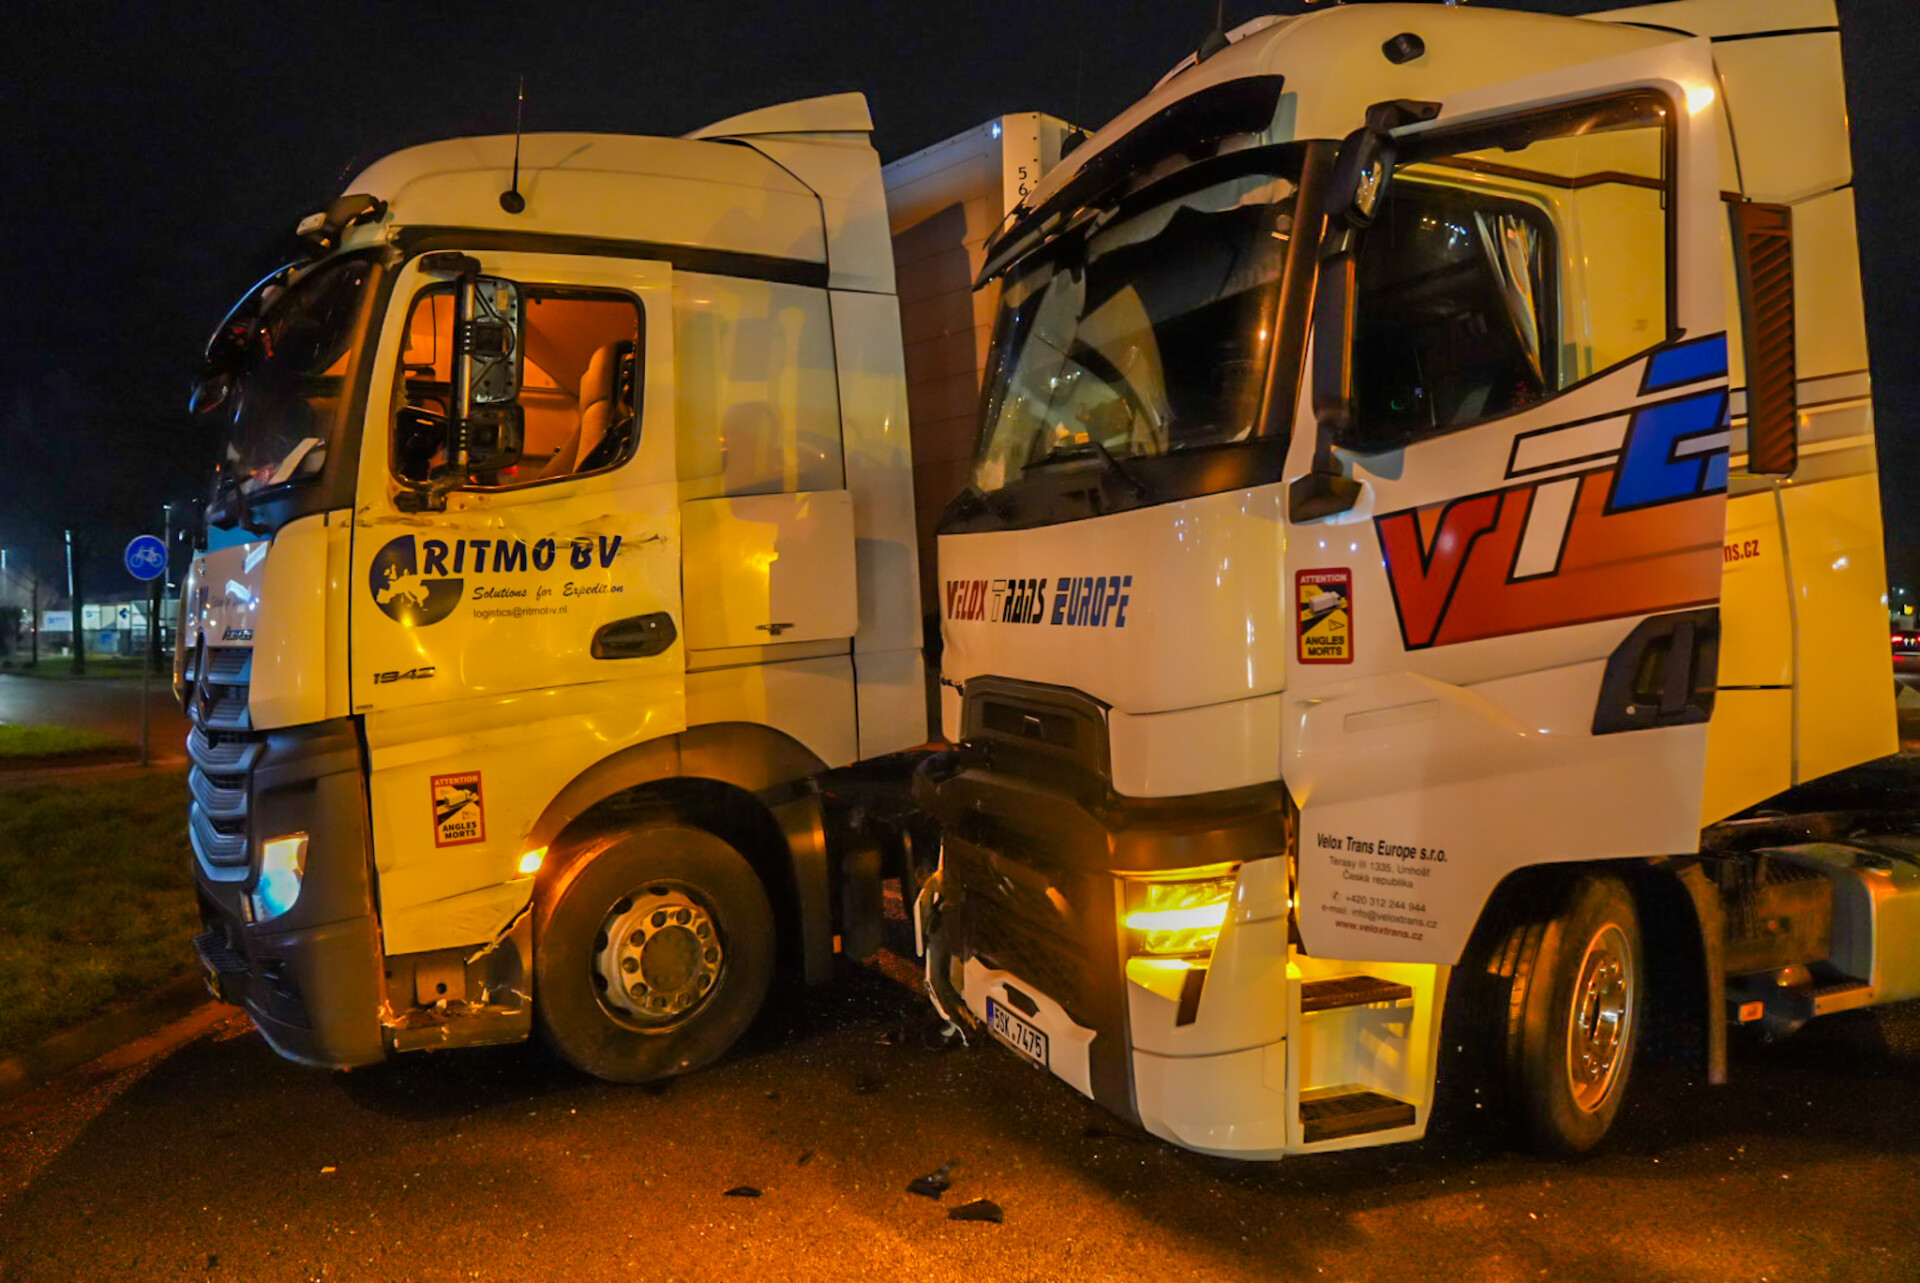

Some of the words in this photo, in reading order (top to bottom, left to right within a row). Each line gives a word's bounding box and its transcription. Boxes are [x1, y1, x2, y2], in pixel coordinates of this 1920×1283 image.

[422, 538, 556, 577] RITMO
[569, 535, 622, 570] BV
[1724, 539, 1760, 563] ns.cz
[1300, 573, 1348, 584] ATTENTION
[472, 586, 528, 600] Solutions
[536, 585, 552, 601] for
[563, 582, 625, 599] Expediton
[1050, 575, 1133, 627] EUROPE
[1305, 635, 1345, 646] ANGLES
[1308, 646, 1343, 657] MORTS
[434, 775, 479, 786] ATTENTION
[442, 821, 478, 832] ANGLES
[444, 829, 477, 840] MORTS
[1317, 832, 1342, 851] Velox
[1346, 836, 1375, 855] Trans
[1377, 840, 1417, 862] Europe
[1420, 847, 1448, 863] s.r.o.
[1372, 875, 1414, 889] republika
[1345, 893, 1368, 906] +420
[1369, 897, 1387, 909] 312
[1351, 908, 1439, 929] info@veloxtrans.cz
[1335, 920, 1424, 941] www.veloxtrans.cz
